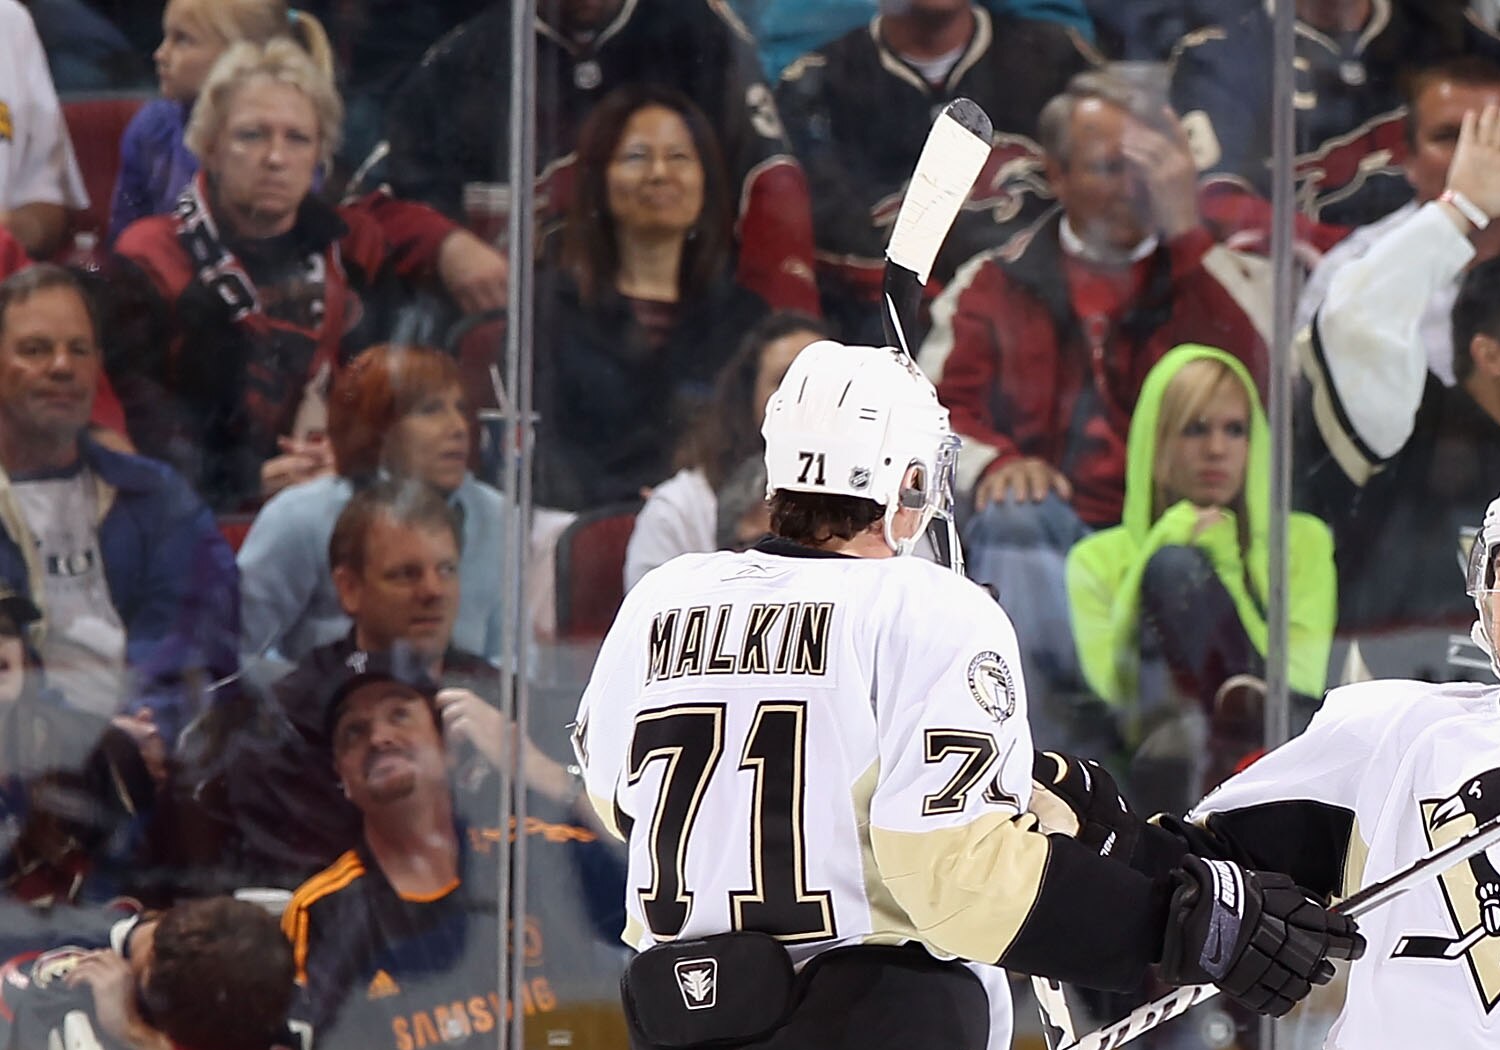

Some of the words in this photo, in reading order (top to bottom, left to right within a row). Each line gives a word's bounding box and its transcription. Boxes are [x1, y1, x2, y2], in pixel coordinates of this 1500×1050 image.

[797, 451, 825, 486] 71
[646, 602, 834, 686] MALKIN
[626, 700, 837, 943] 71
